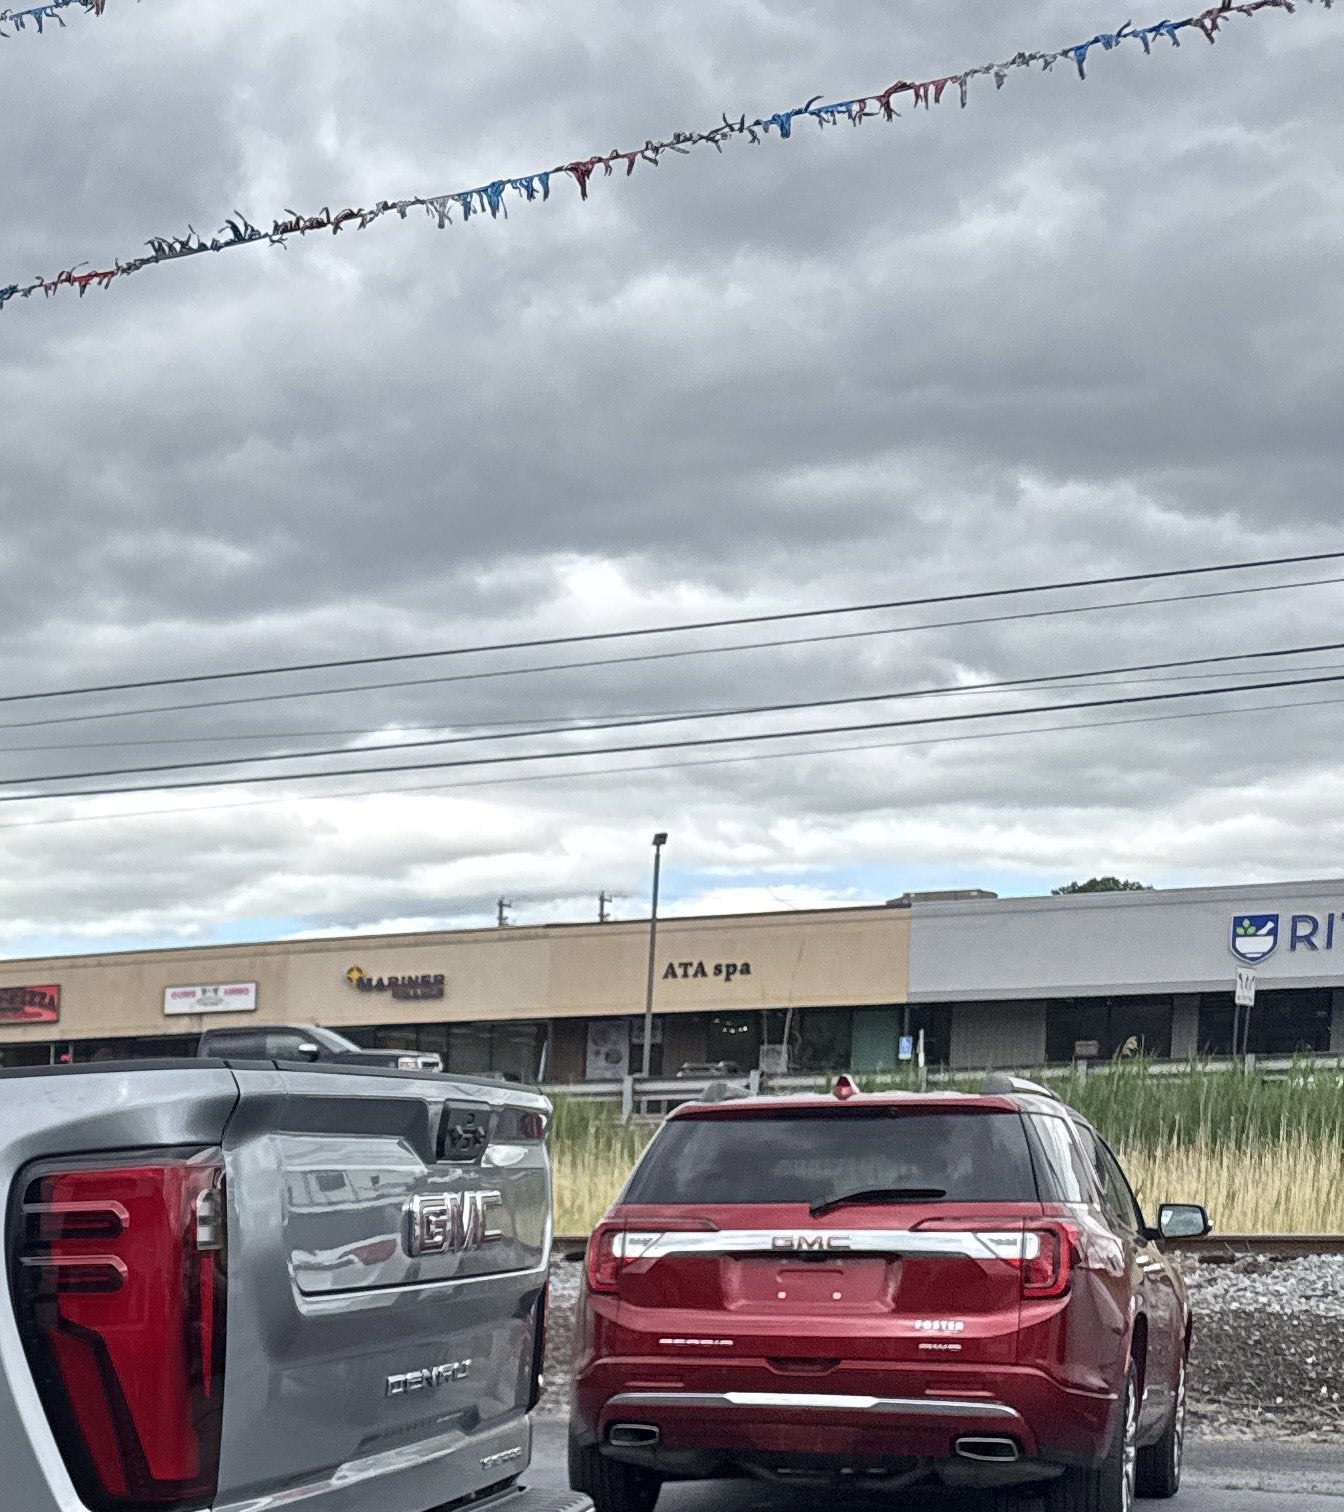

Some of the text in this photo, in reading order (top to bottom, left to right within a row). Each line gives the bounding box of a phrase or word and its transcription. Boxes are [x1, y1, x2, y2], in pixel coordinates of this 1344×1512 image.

[1290, 912, 1344, 952] RI
[661, 960, 752, 983] ATA spa
[410, 1190, 502, 1255] GMC
[771, 1234, 851, 1252] GMC
[385, 1358, 472, 1397] DENALI
